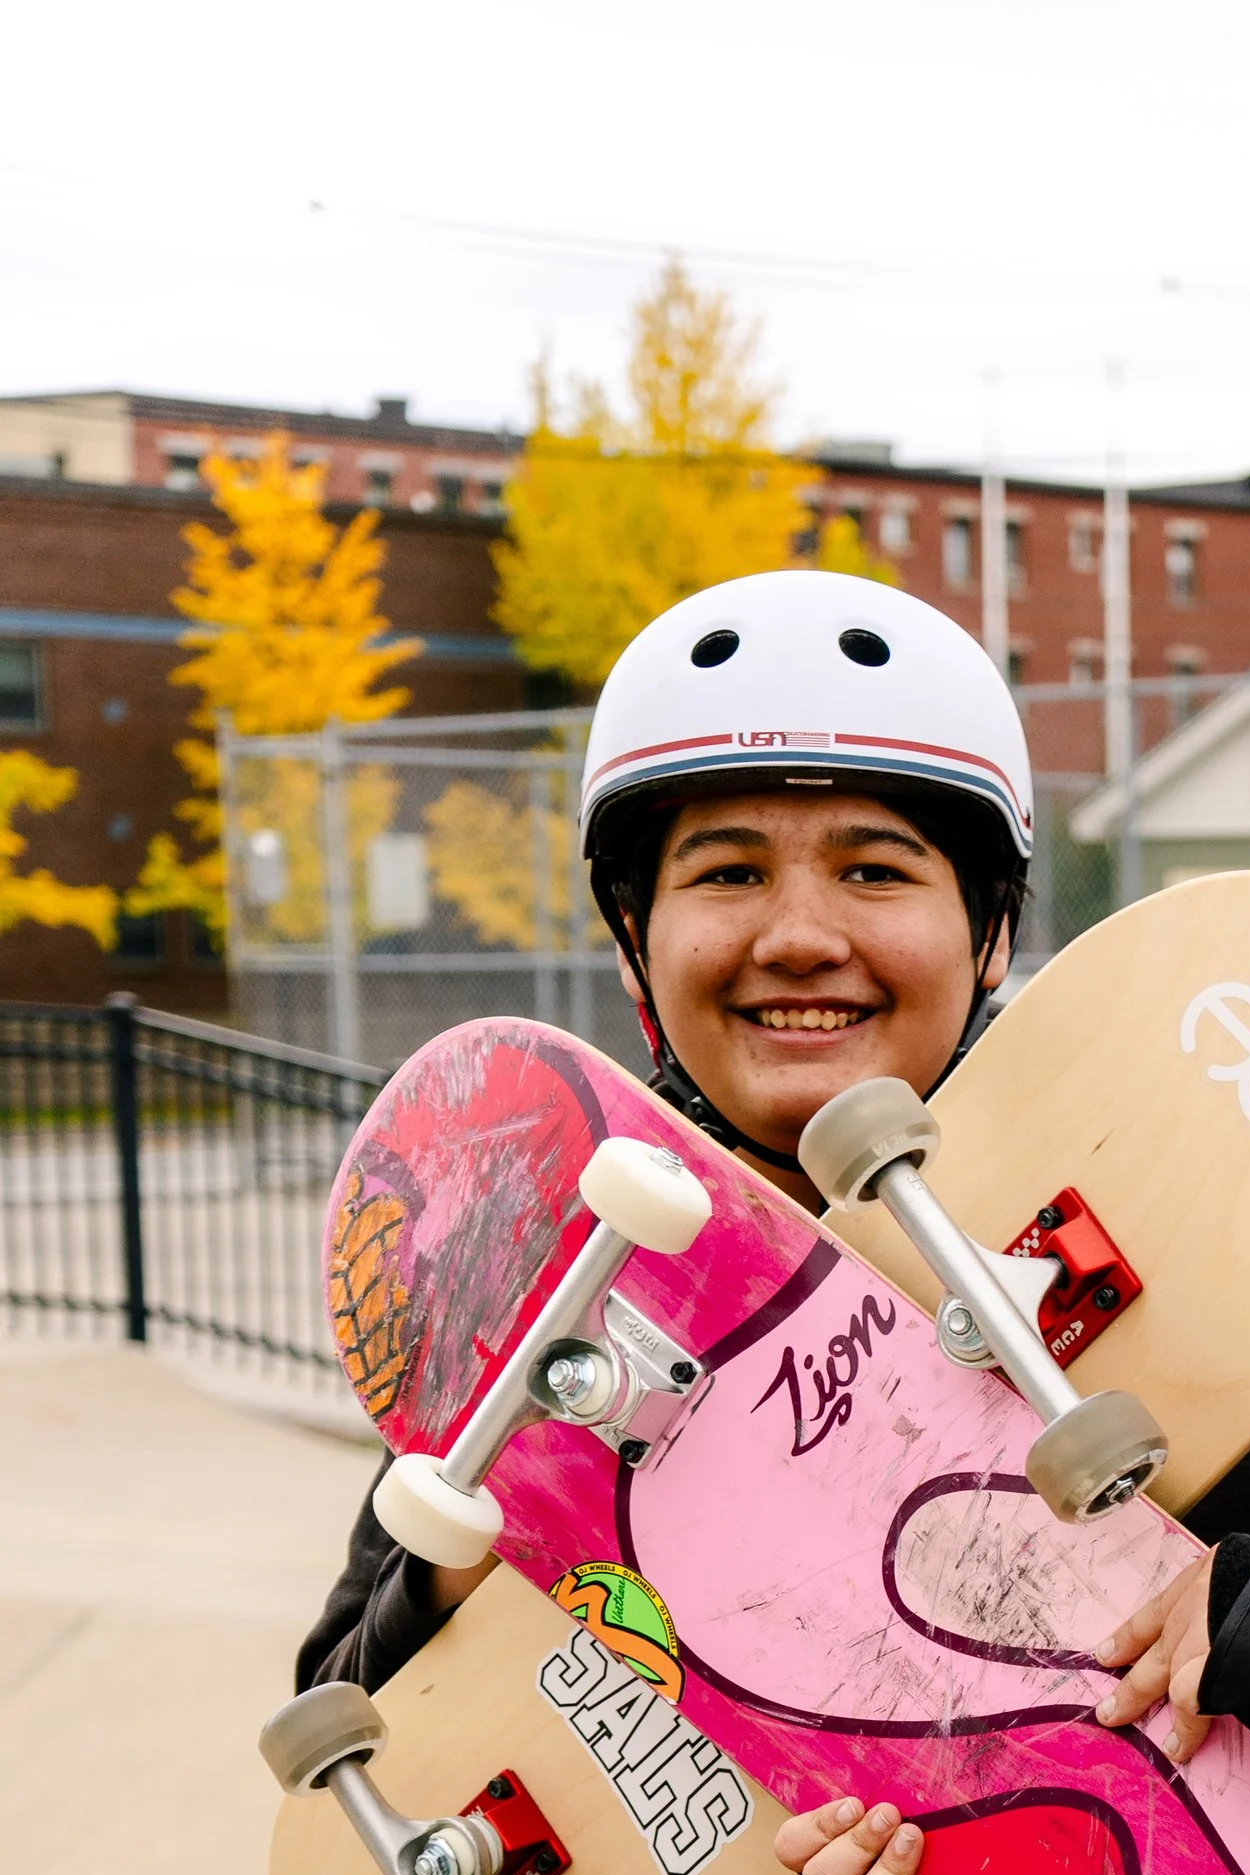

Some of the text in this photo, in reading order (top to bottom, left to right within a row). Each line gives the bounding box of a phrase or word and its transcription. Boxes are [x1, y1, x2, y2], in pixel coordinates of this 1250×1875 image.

[1051, 1320, 1084, 1356] ACE
[750, 1294, 896, 1457] Zion
[578, 1563, 616, 1575] OJ WHEELS
[622, 1569, 657, 1600] OJ WHEELS
[659, 1605, 677, 1650] OJ WHEELS
